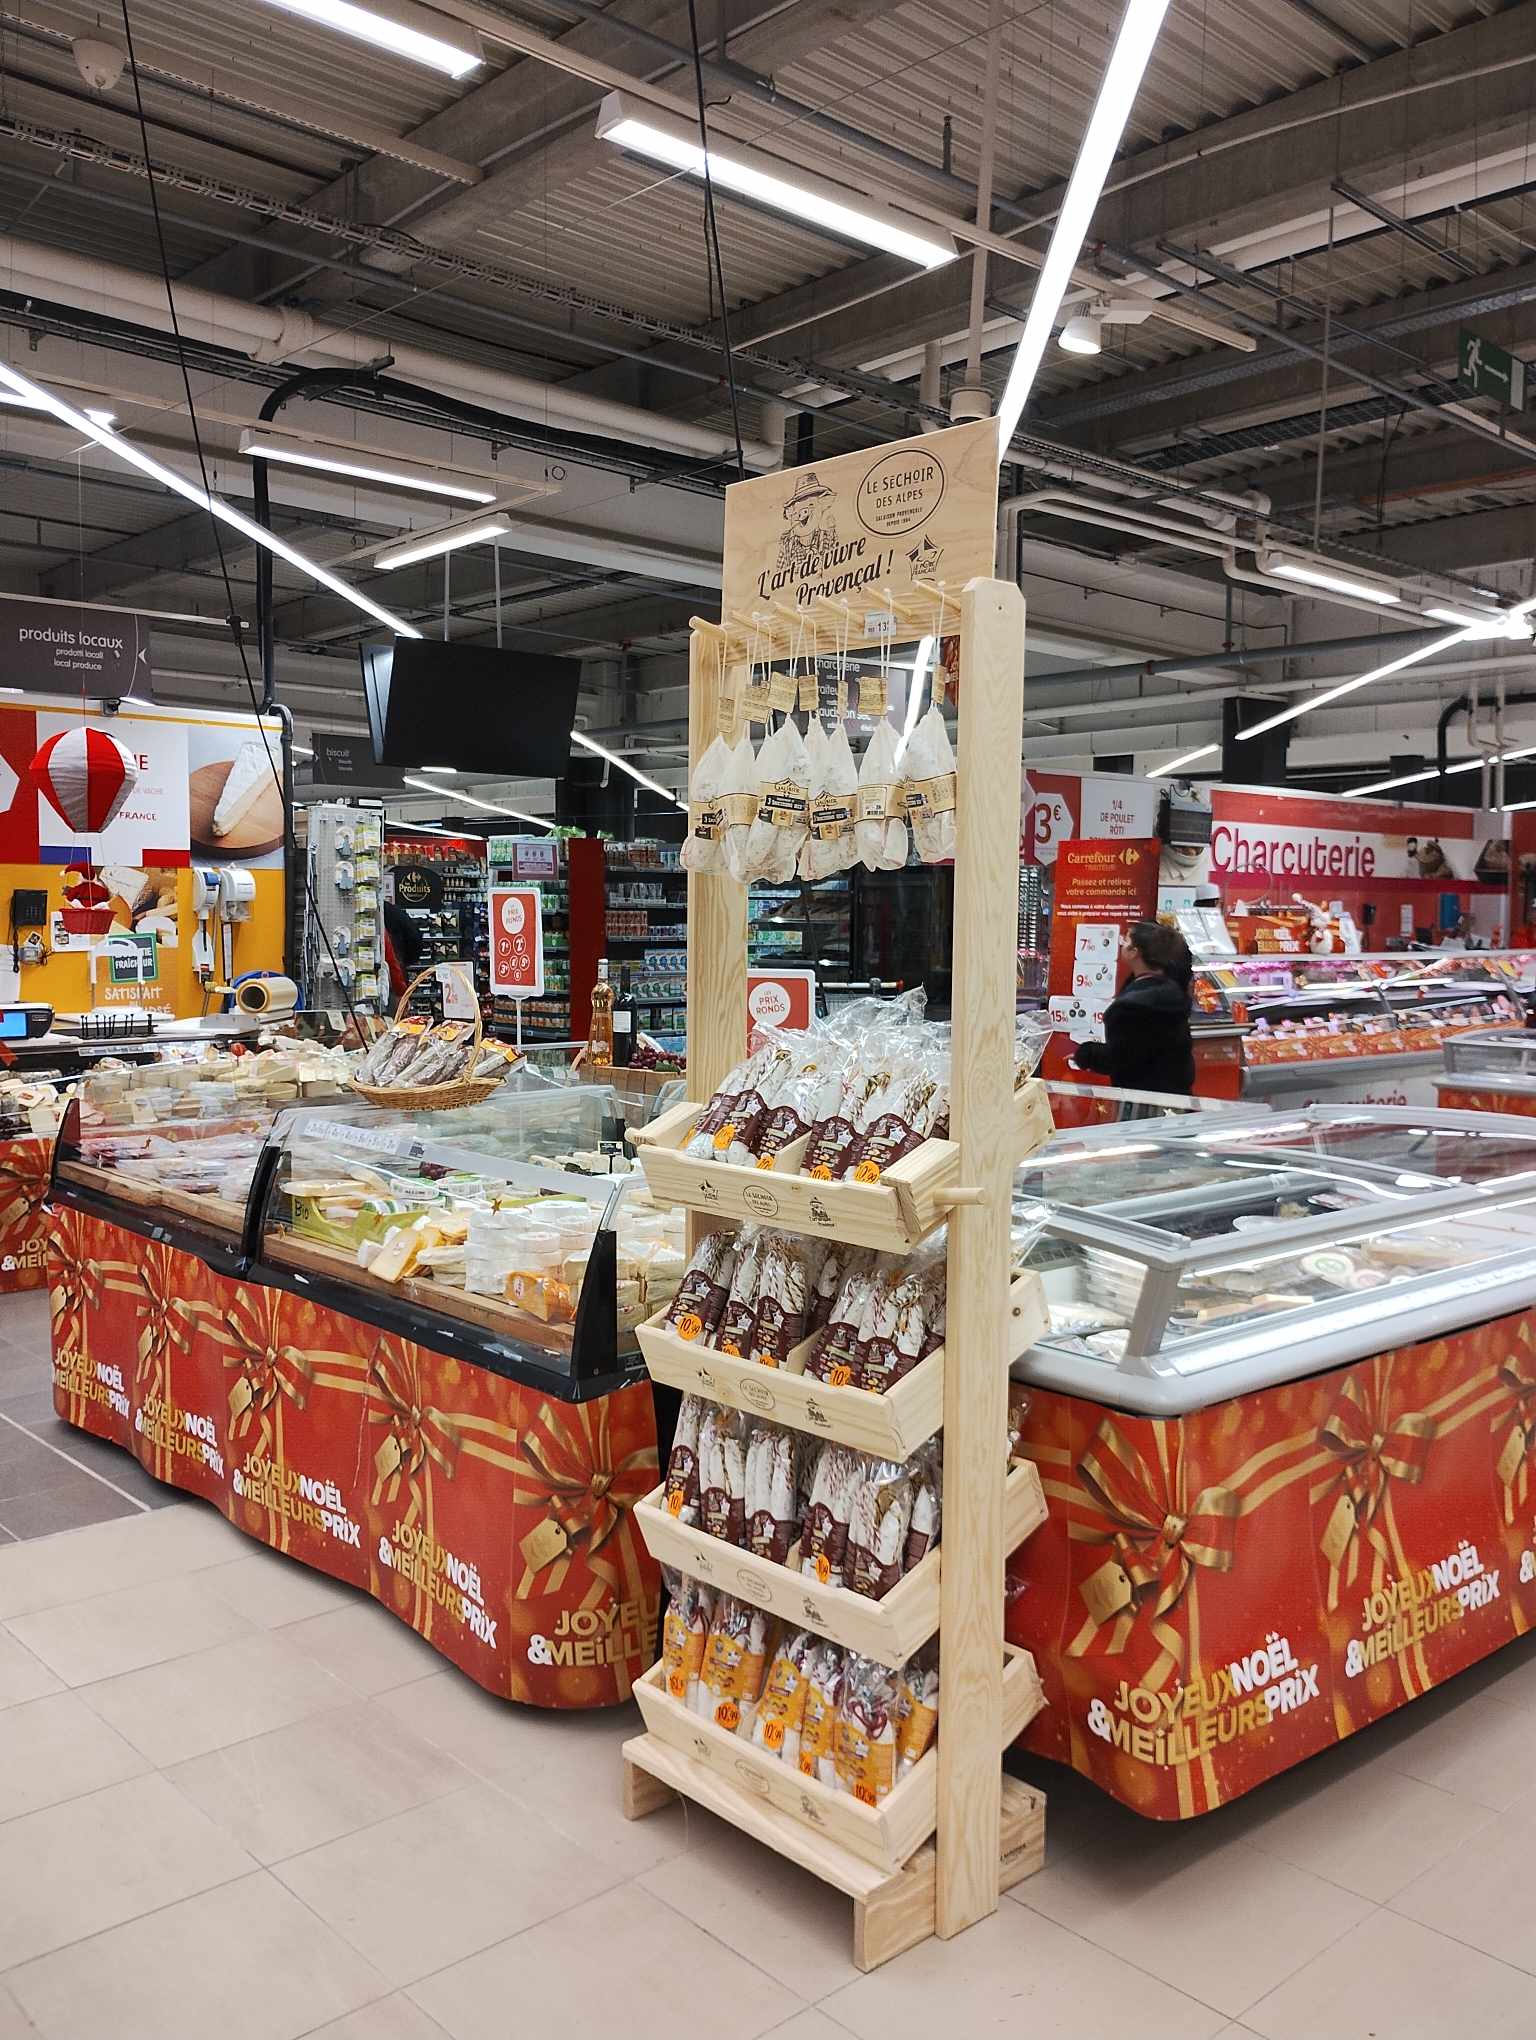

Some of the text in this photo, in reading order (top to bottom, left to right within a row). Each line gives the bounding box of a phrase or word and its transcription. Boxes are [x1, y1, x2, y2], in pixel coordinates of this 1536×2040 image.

[866, 481, 878, 495] LE
[876, 488, 923, 509] DES ALPES
[799, 553, 820, 579] de
[823, 537, 866, 570] vivre
[795, 553, 883, 606] Provençal
[19, 628, 123, 649] produits locaux
[53, 658, 102, 672] local produce
[119, 811, 157, 821] FRANCE
[1110, 814, 1135, 824] POULET
[1067, 851, 1116, 864] Carrefour
[1211, 826, 1375, 878] Charcuterie
[399, 883, 431, 893] Produits
[1086, 887, 1126, 896] commande
[115, 957, 153, 970] FRAÎCHUR
[755, 1003, 786, 1015] RONDS
[758, 994, 779, 1006] PRIX
[17, 1238, 48, 1254] JOY
[97, 1362, 125, 1393] NOËL
[185, 1412, 217, 1448] NOËL
[243, 1452, 346, 1514] JOYEUX NOËL
[392, 1520, 484, 1606] JOYEUX NOËL
[1361, 1539, 1485, 1632] JOYEUX NOËL
[554, 1594, 660, 1637] JOYEU
[1113, 1630, 1299, 1724] JOYEUX NOËL
